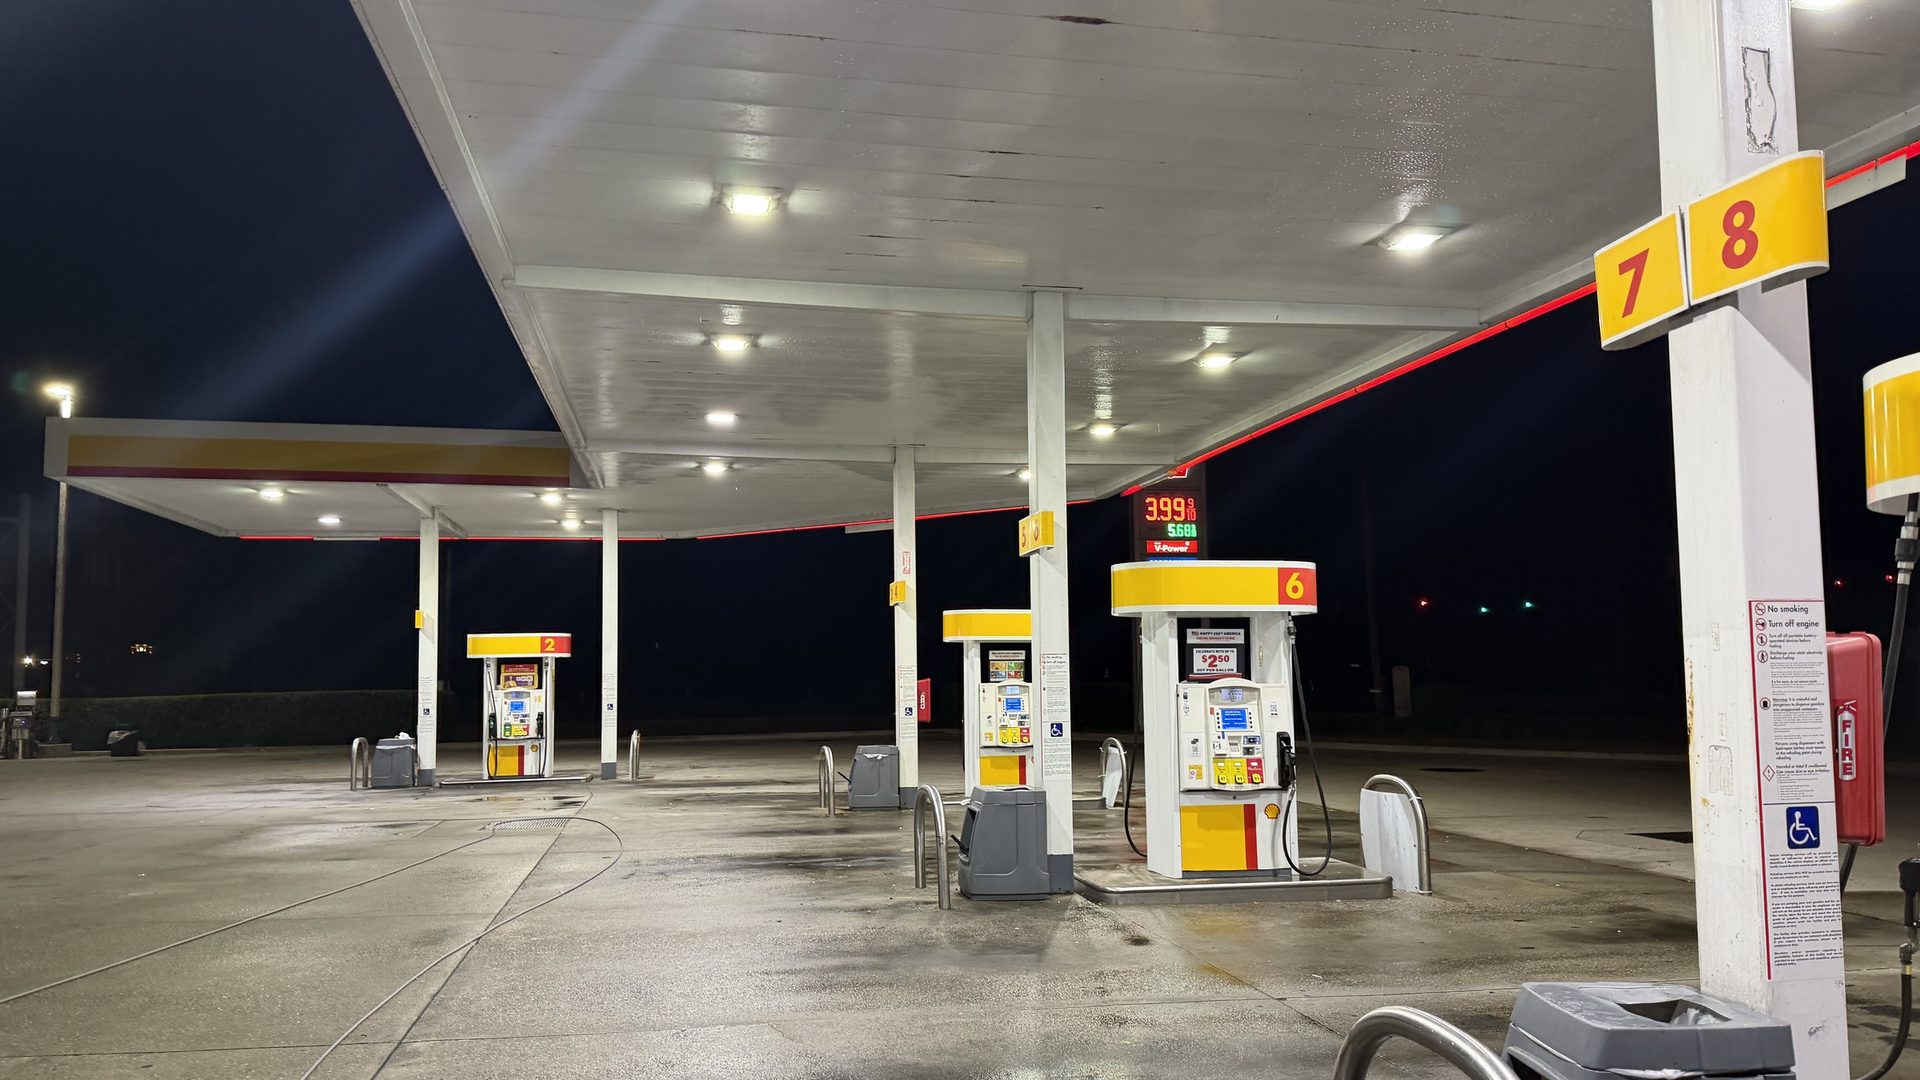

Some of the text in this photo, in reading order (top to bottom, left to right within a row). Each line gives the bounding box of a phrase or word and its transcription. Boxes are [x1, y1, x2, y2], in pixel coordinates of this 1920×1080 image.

[1722, 200, 1759, 270] 8
[1618, 247, 1650, 318] 7
[1145, 497, 1186, 521] 3.99
[1154, 544, 1188, 552] V-Power
[1286, 572, 1304, 600] 6
[1768, 604, 1808, 614] No smoking
[1768, 619, 1820, 629] Turn off engine
[544, 637, 555, 652] 2
[1842, 720, 1853, 776] FIRE
